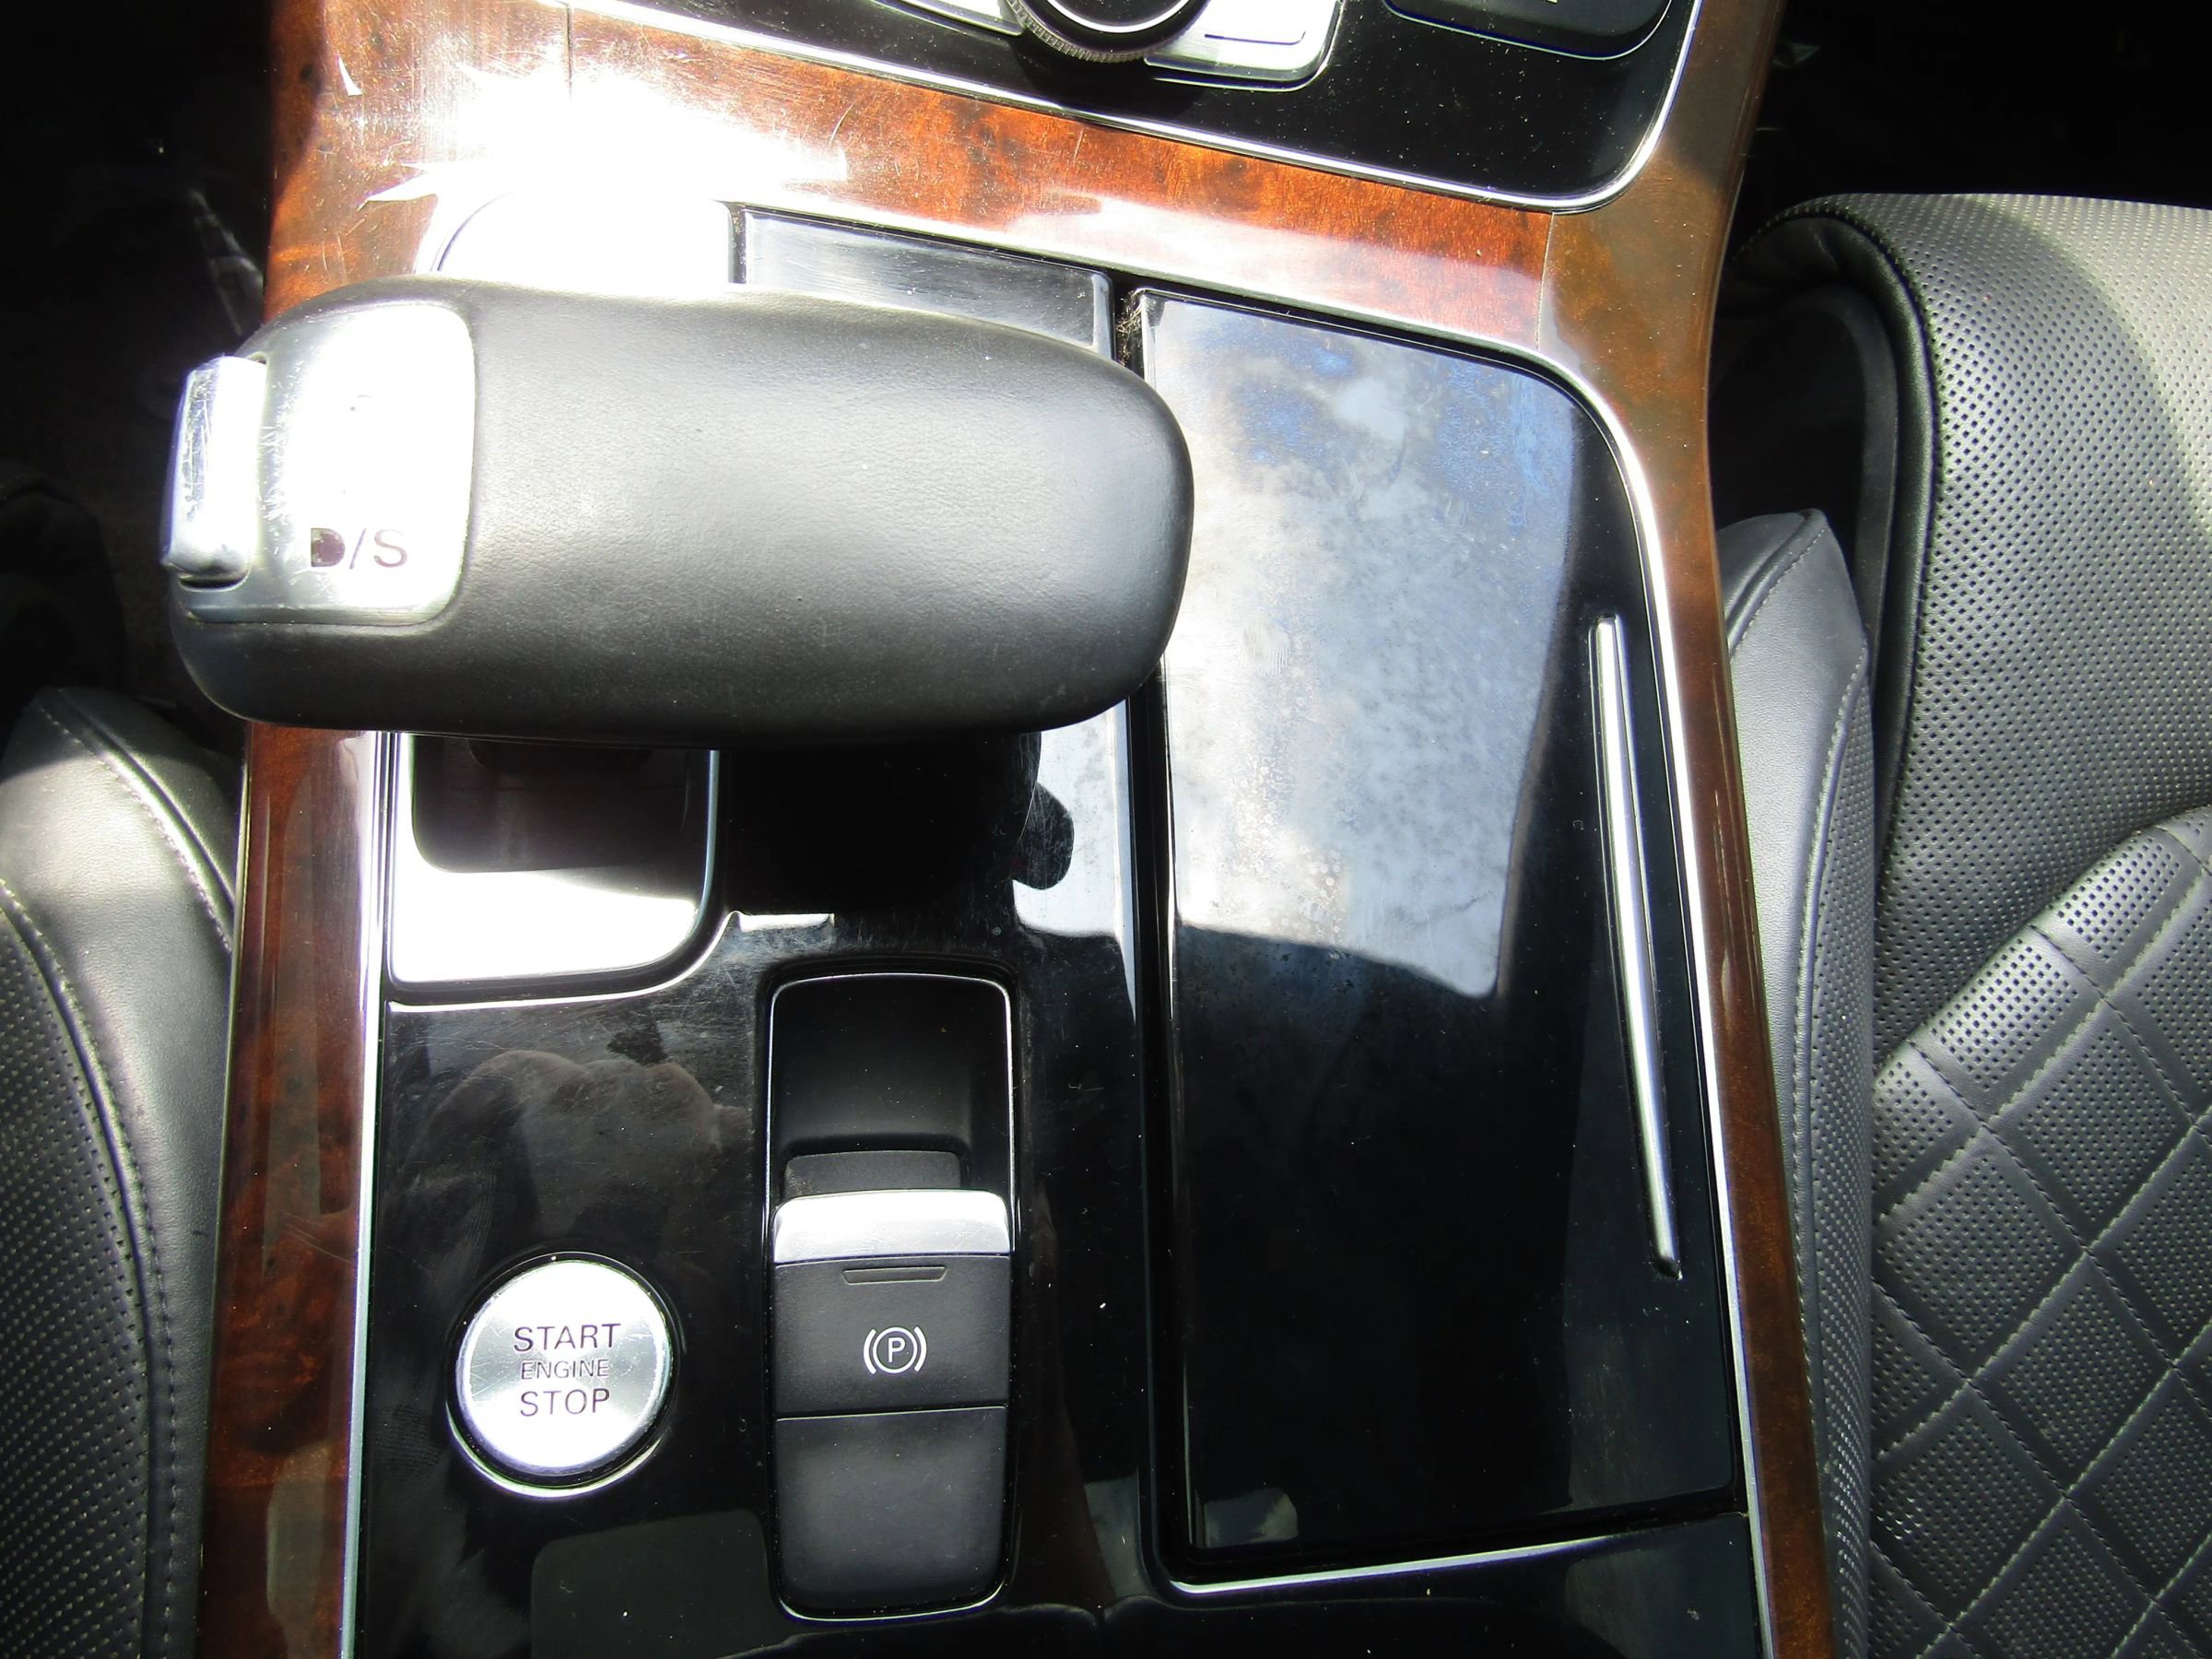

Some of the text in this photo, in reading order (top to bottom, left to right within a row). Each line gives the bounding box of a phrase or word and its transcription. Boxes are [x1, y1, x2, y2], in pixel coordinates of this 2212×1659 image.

[311, 528, 407, 570] D/S
[513, 1324, 620, 1351] START
[888, 1337, 905, 1363] P
[521, 1359, 608, 1380] ENGINE
[520, 1388, 610, 1417] STOP
